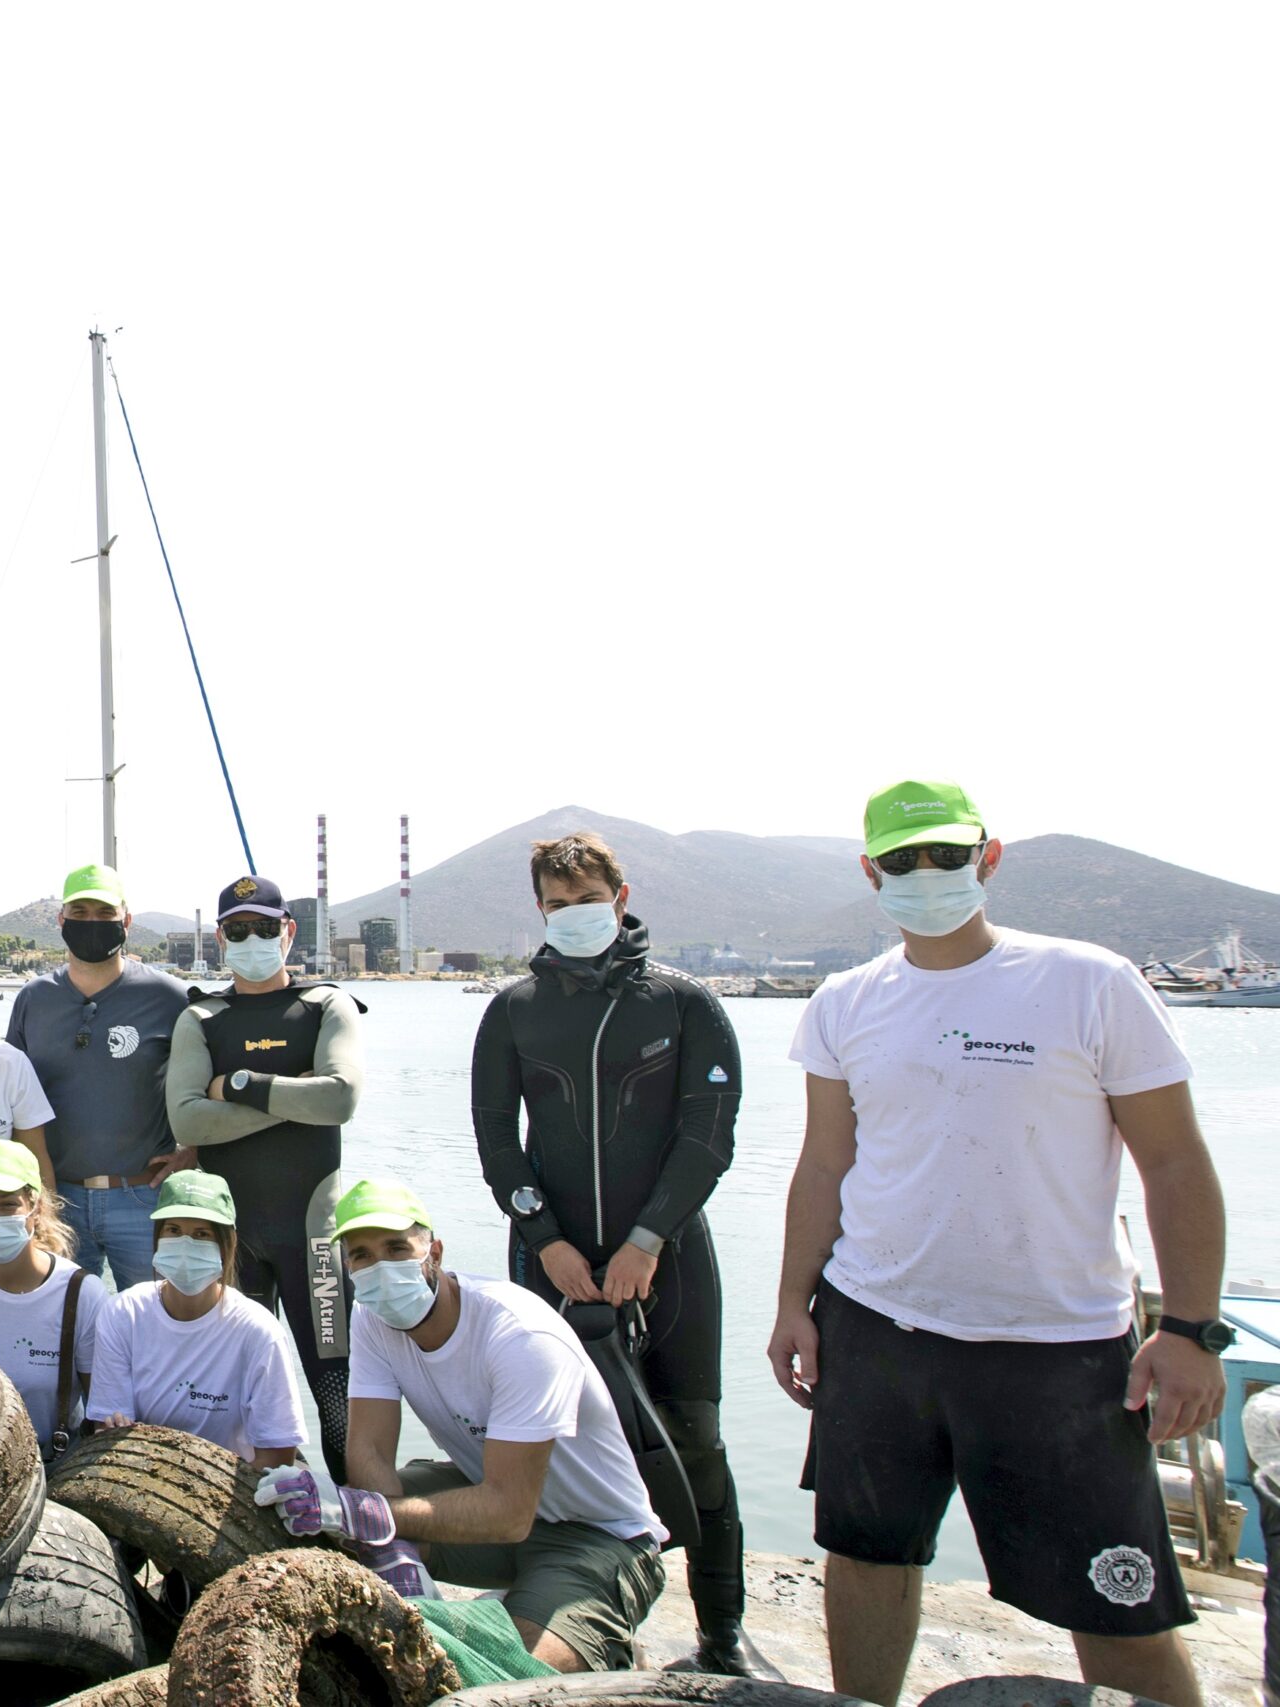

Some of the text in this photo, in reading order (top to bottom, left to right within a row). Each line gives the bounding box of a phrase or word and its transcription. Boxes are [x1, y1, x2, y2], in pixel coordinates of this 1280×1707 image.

[963, 1040, 1035, 1054] geocycle
[29, 1349, 61, 1359] geocyc
[190, 1391, 229, 1404] geocycle
